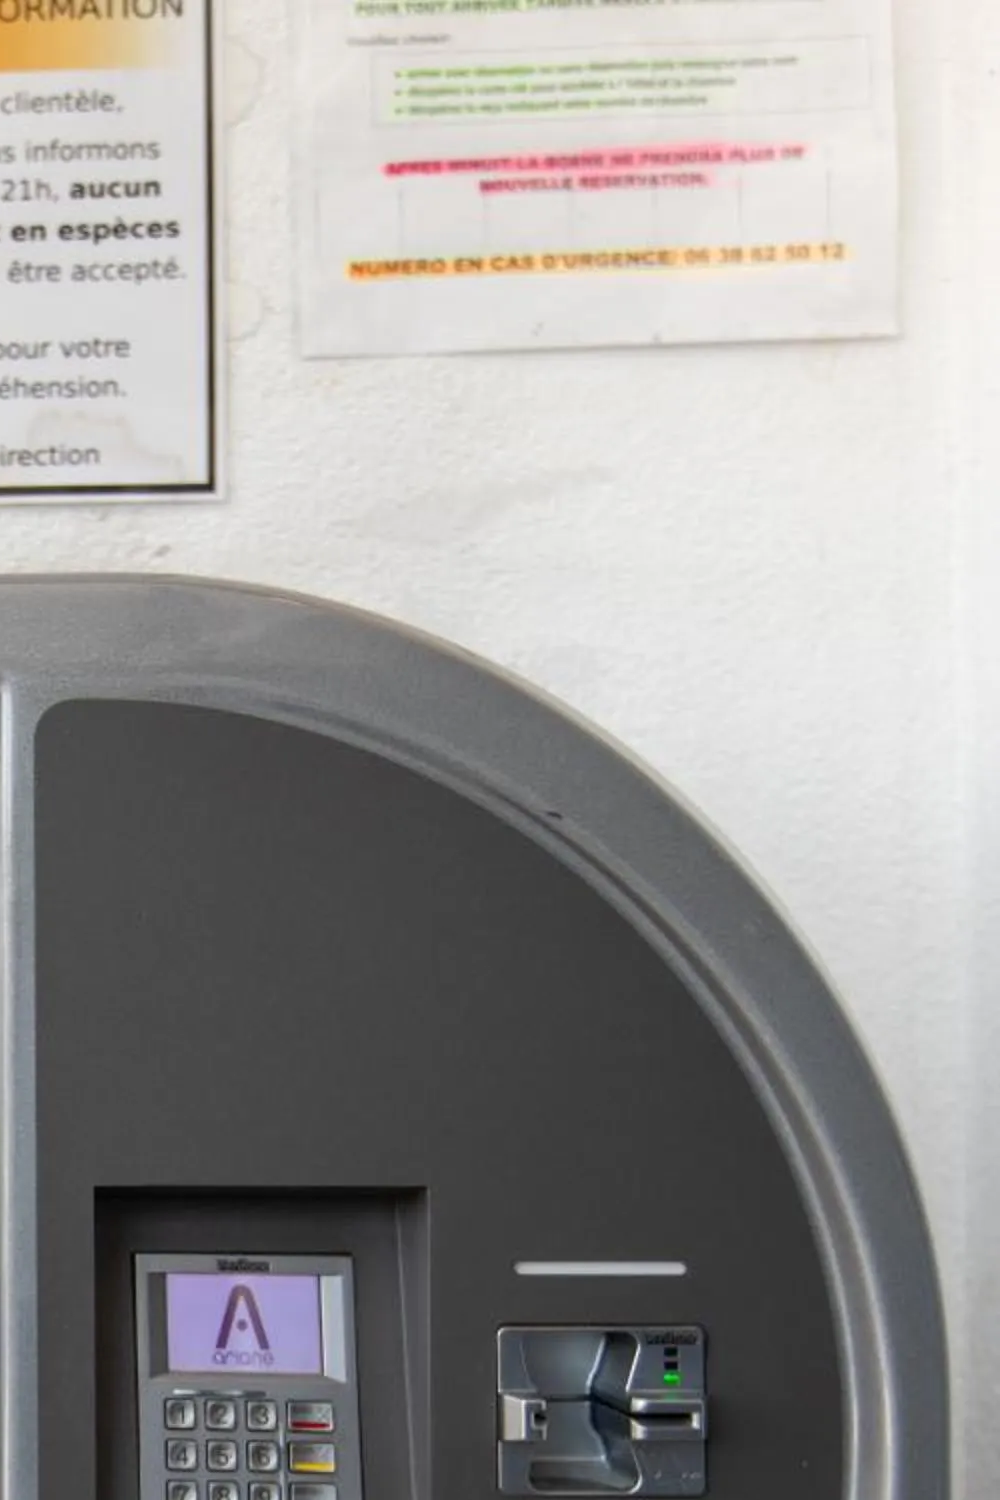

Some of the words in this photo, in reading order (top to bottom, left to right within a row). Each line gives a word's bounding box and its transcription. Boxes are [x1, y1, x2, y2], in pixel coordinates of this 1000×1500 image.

[0, 89, 125, 117] clientèle,
[25, 139, 161, 163] informons
[0, 180, 60, 205] 21h,
[69, 179, 163, 201] aucun
[10, 223, 47, 242] en
[57, 218, 182, 246] espèces
[7, 261, 62, 284] être
[71, 257, 187, 286] accepté.
[350, 257, 447, 278] NUMERO
[453, 257, 483, 272] EN
[490, 255, 534, 272] CAS
[60, 338, 131, 360] votre
[174, 1445, 190, 1466] 4
